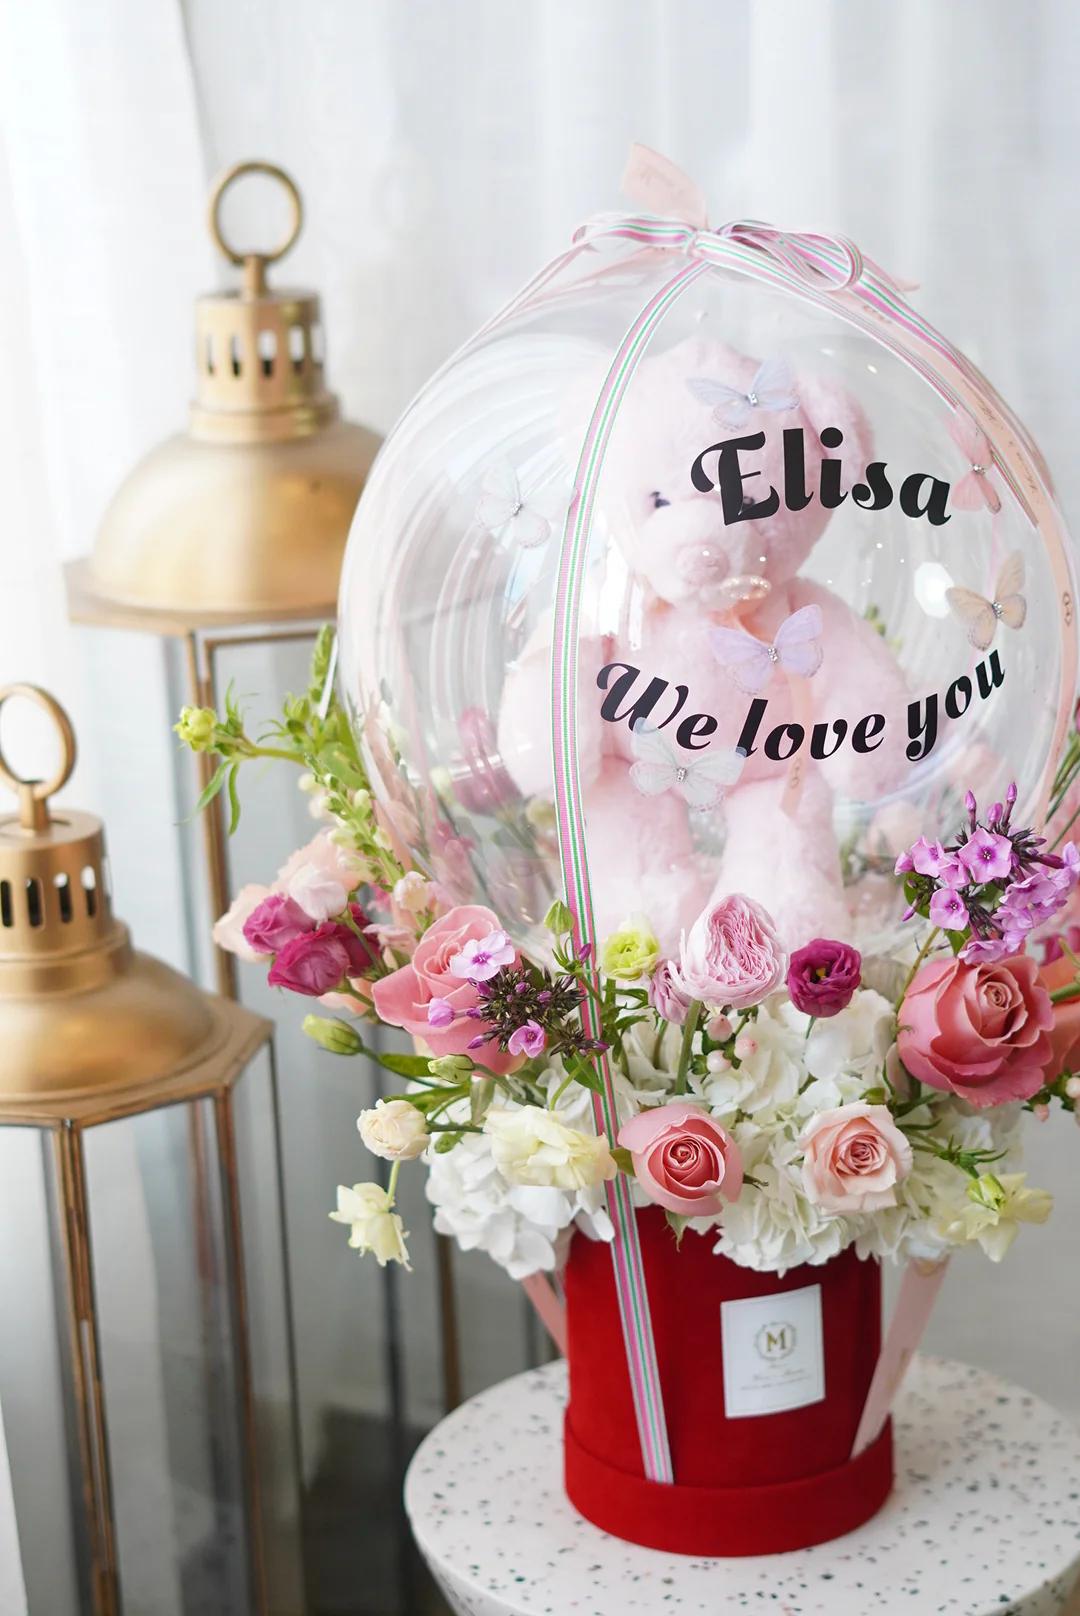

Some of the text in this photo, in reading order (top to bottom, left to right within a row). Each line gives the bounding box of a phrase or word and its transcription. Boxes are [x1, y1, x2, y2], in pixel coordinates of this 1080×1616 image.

[690, 427, 952, 526] Elisa
[596, 648, 1006, 762] We love you
[765, 1328, 787, 1353] M
